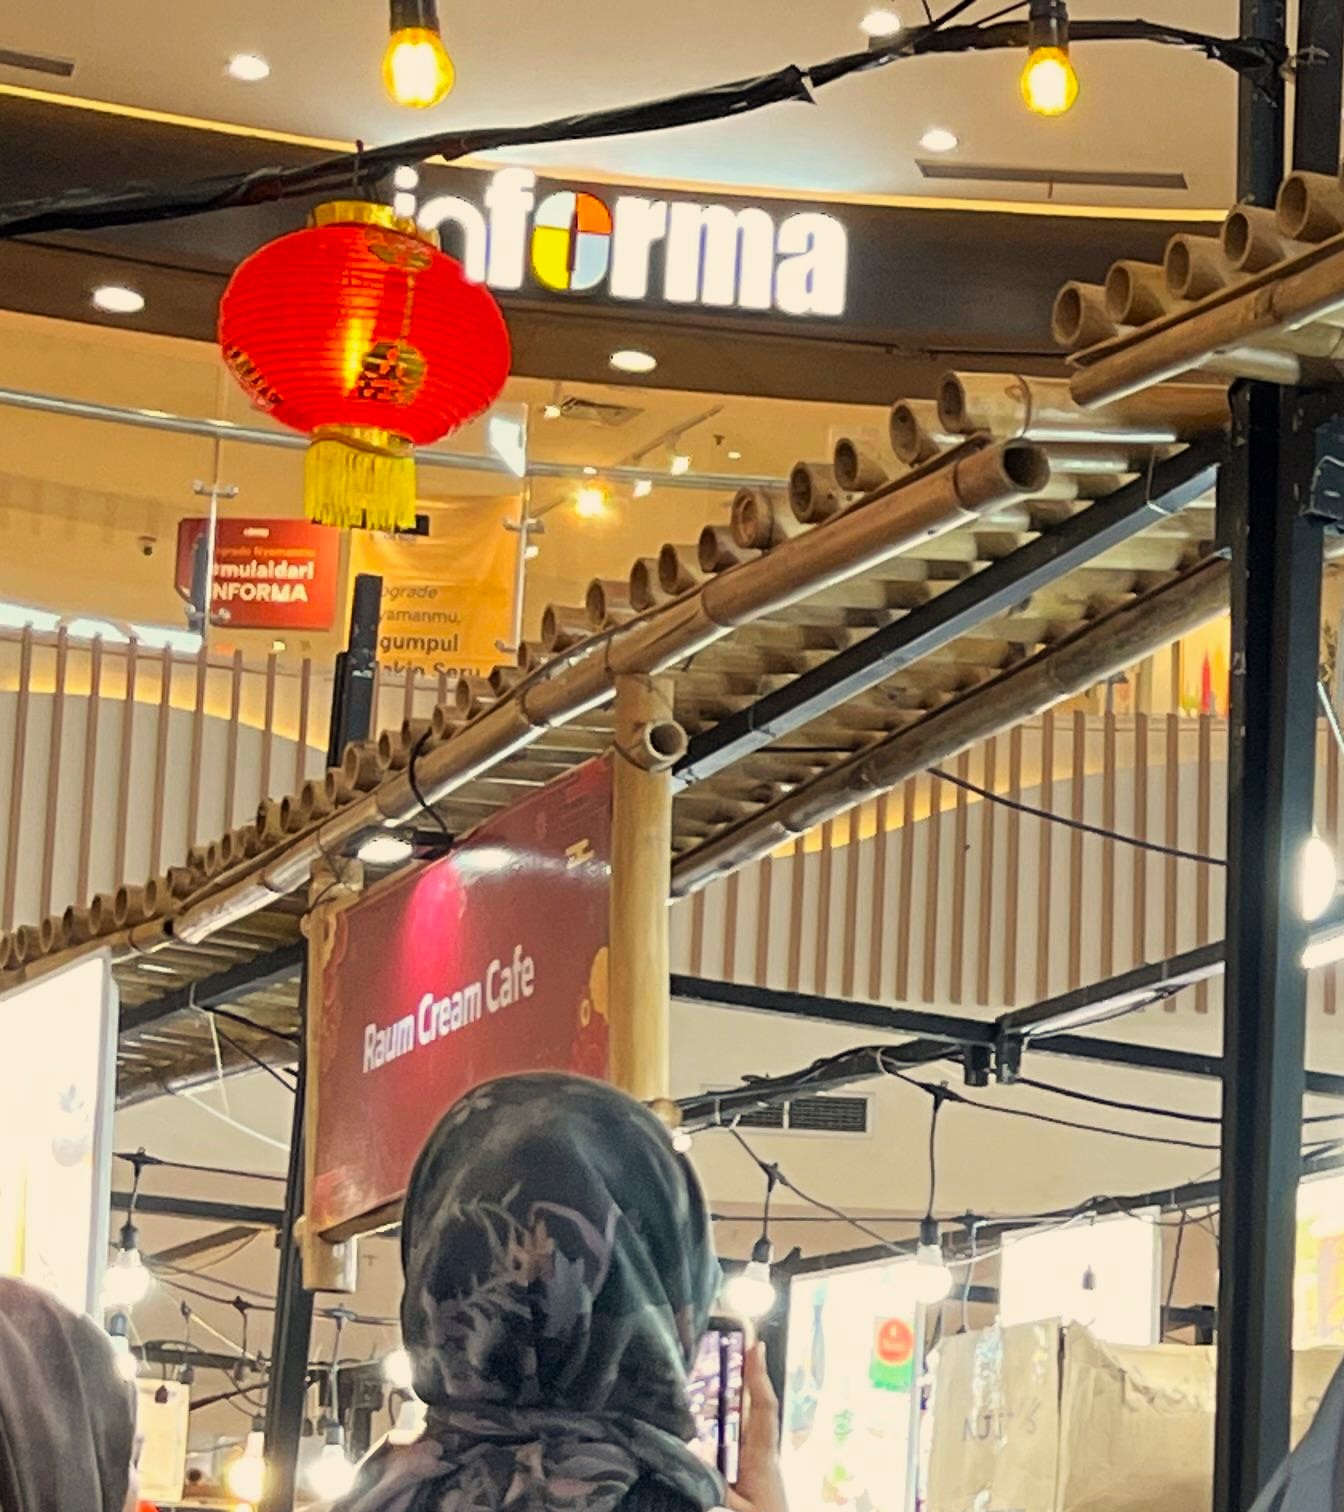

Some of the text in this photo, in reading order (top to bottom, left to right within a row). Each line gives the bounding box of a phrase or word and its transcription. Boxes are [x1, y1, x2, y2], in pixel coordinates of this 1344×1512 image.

[362, 943, 535, 1074] Raum Cream Cafe
